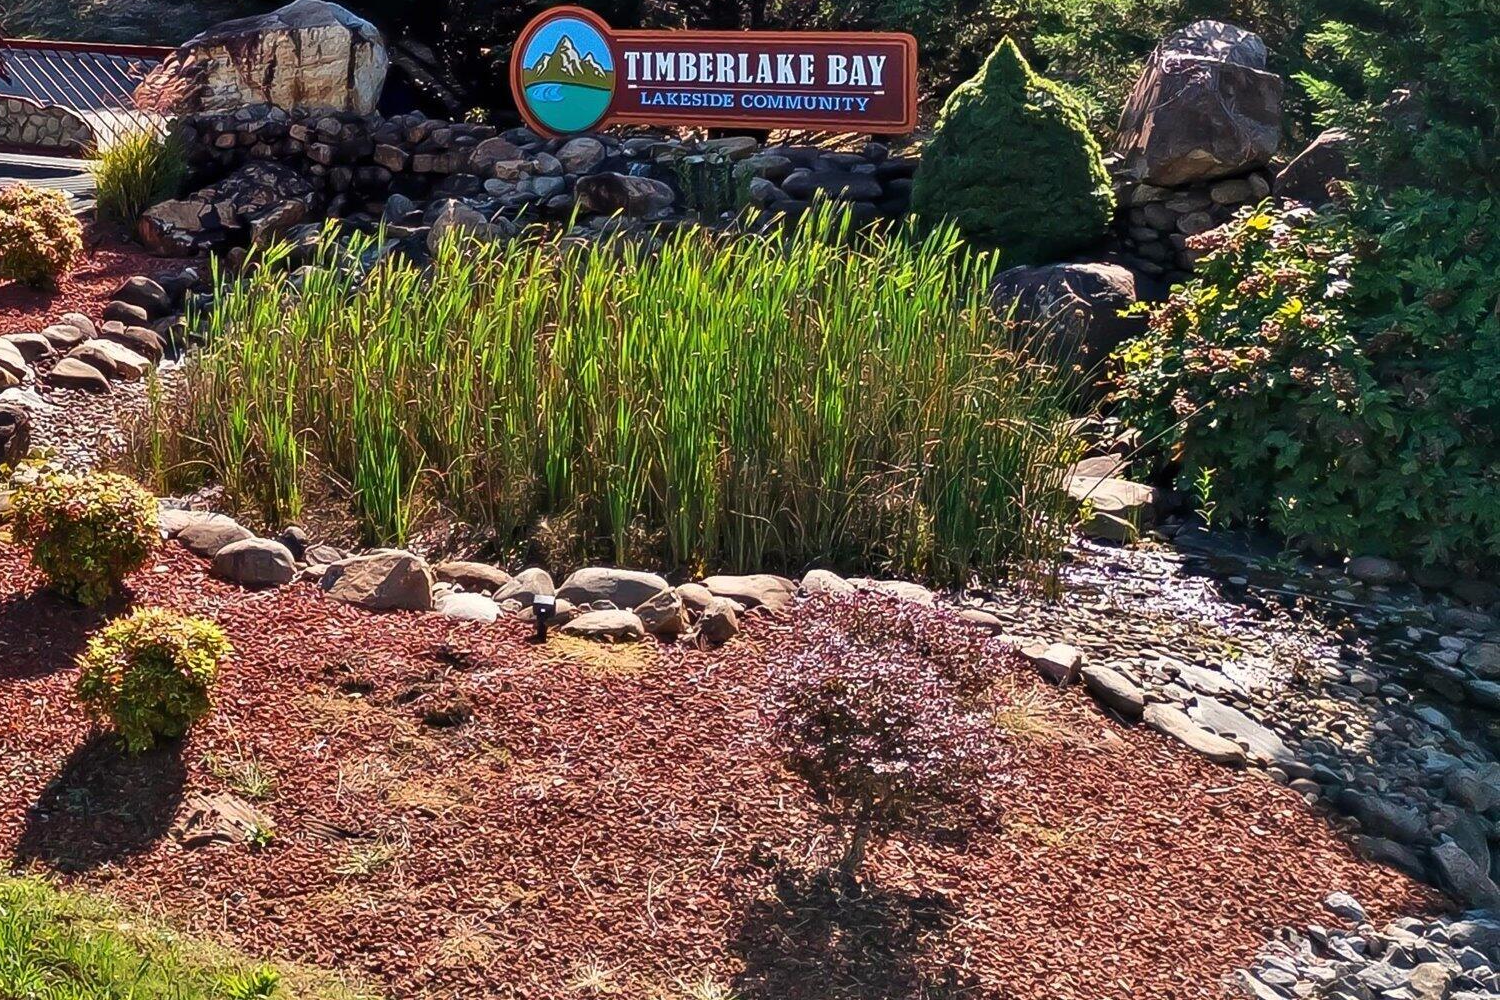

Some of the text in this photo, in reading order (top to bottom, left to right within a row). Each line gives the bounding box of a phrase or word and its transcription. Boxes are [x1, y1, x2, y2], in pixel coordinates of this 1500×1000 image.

[624, 51, 887, 86] TIMBERLAKE BAY
[640, 91, 870, 112] LAKESIDE COMMUNITY
